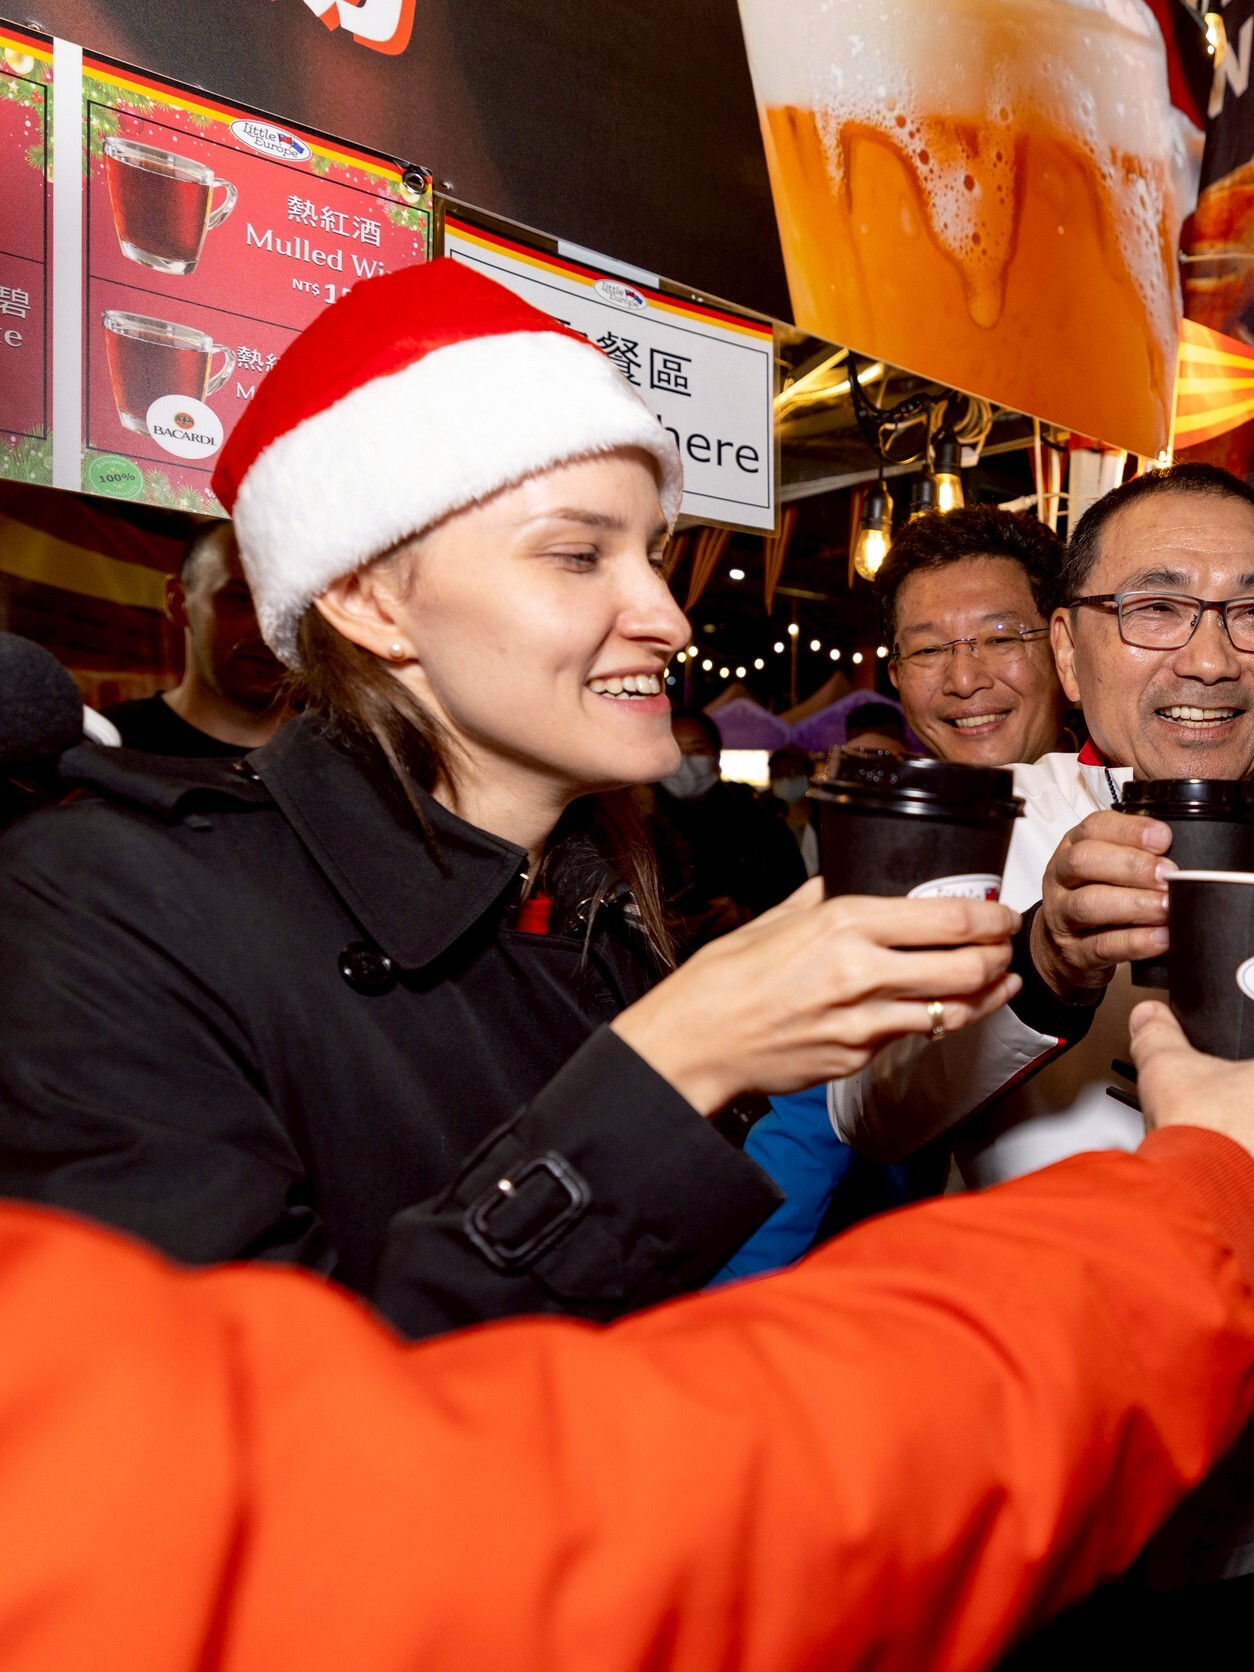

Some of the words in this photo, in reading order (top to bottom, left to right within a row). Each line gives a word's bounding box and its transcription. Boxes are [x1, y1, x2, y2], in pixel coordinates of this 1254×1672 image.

[243, 122, 277, 142] Little
[254, 136, 298, 158] Europe
[287, 195, 382, 248] 熱紅酒
[246, 222, 344, 273] Mulled
[351, 253, 392, 280] Wi
[292, 277, 321, 297] NT$
[324, 283, 352, 305] 1
[601, 281, 624, 296] Little
[609, 293, 639, 309] Europe
[0, 327, 23, 348] e
[557, 317, 692, 398] 餐區
[153, 425, 217, 446] BACARDI
[99, 472, 136, 483] 100%
